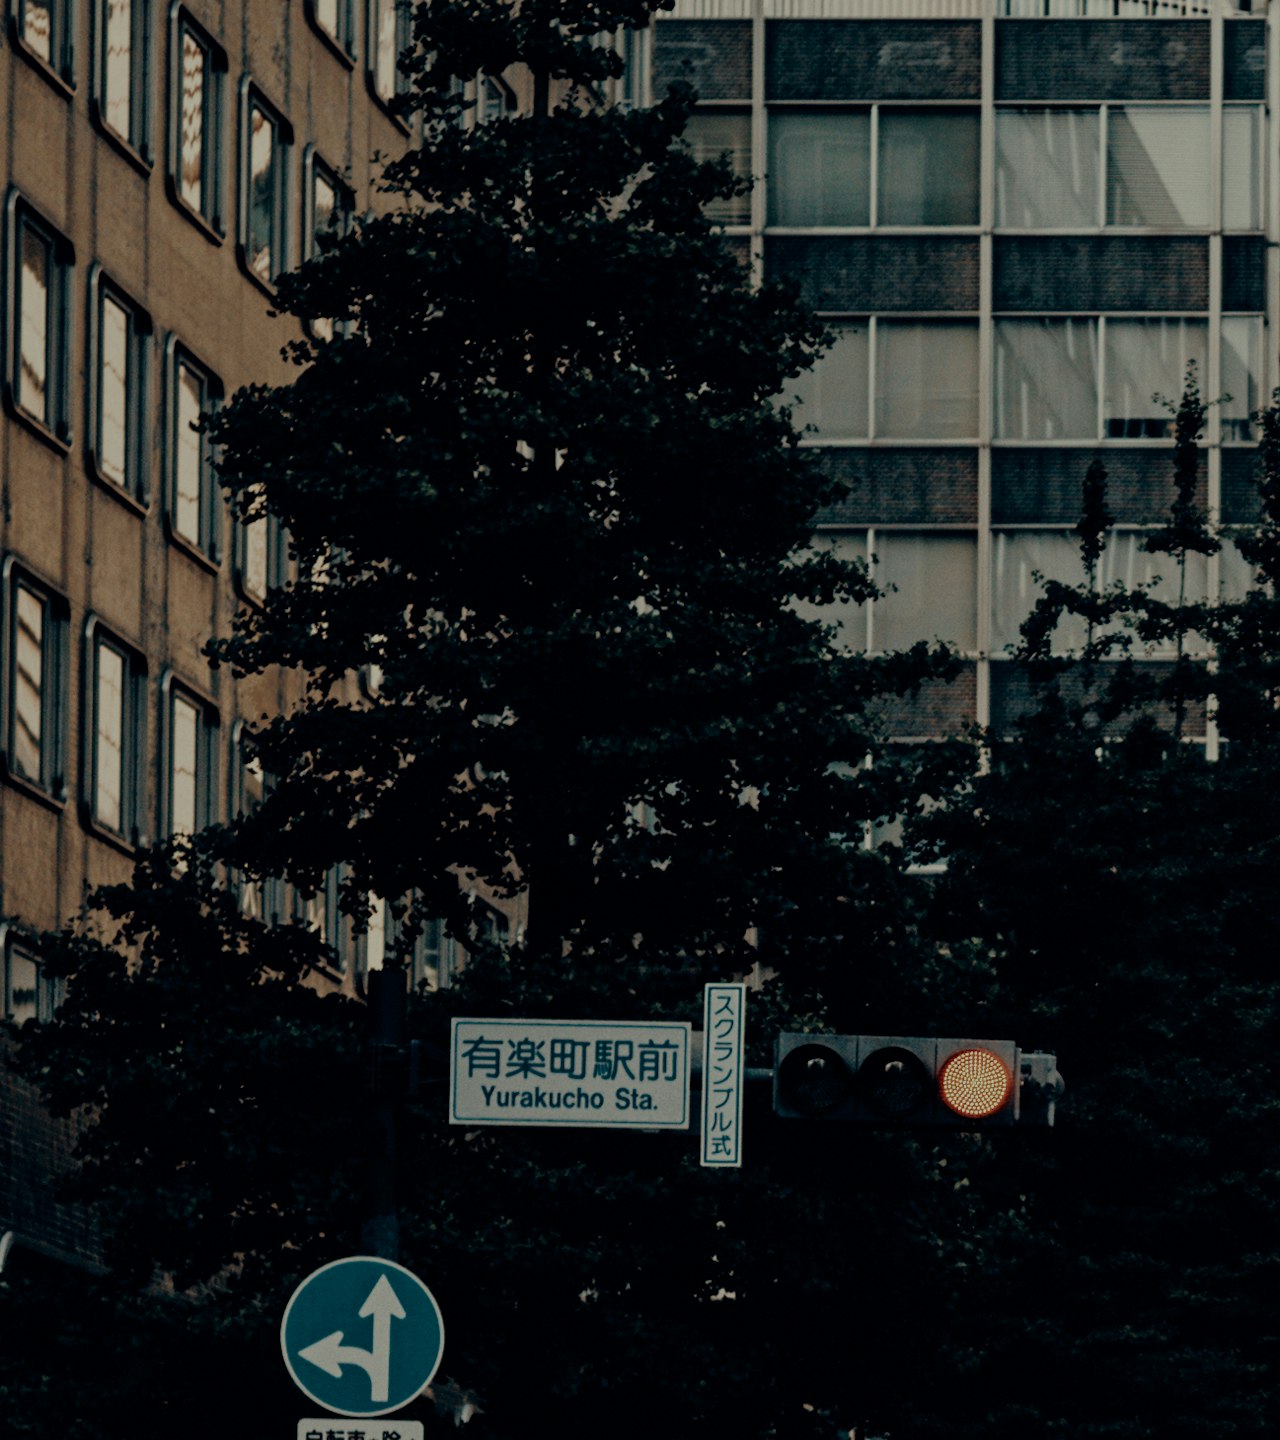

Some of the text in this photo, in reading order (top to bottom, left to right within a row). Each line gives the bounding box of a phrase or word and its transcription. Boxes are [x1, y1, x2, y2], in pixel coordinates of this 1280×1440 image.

[461, 1035, 679, 1082] 有楽町駅前
[710, 995, 736, 1157] スクランブル式
[481, 1085, 658, 1111] Yurakucho Sta.
